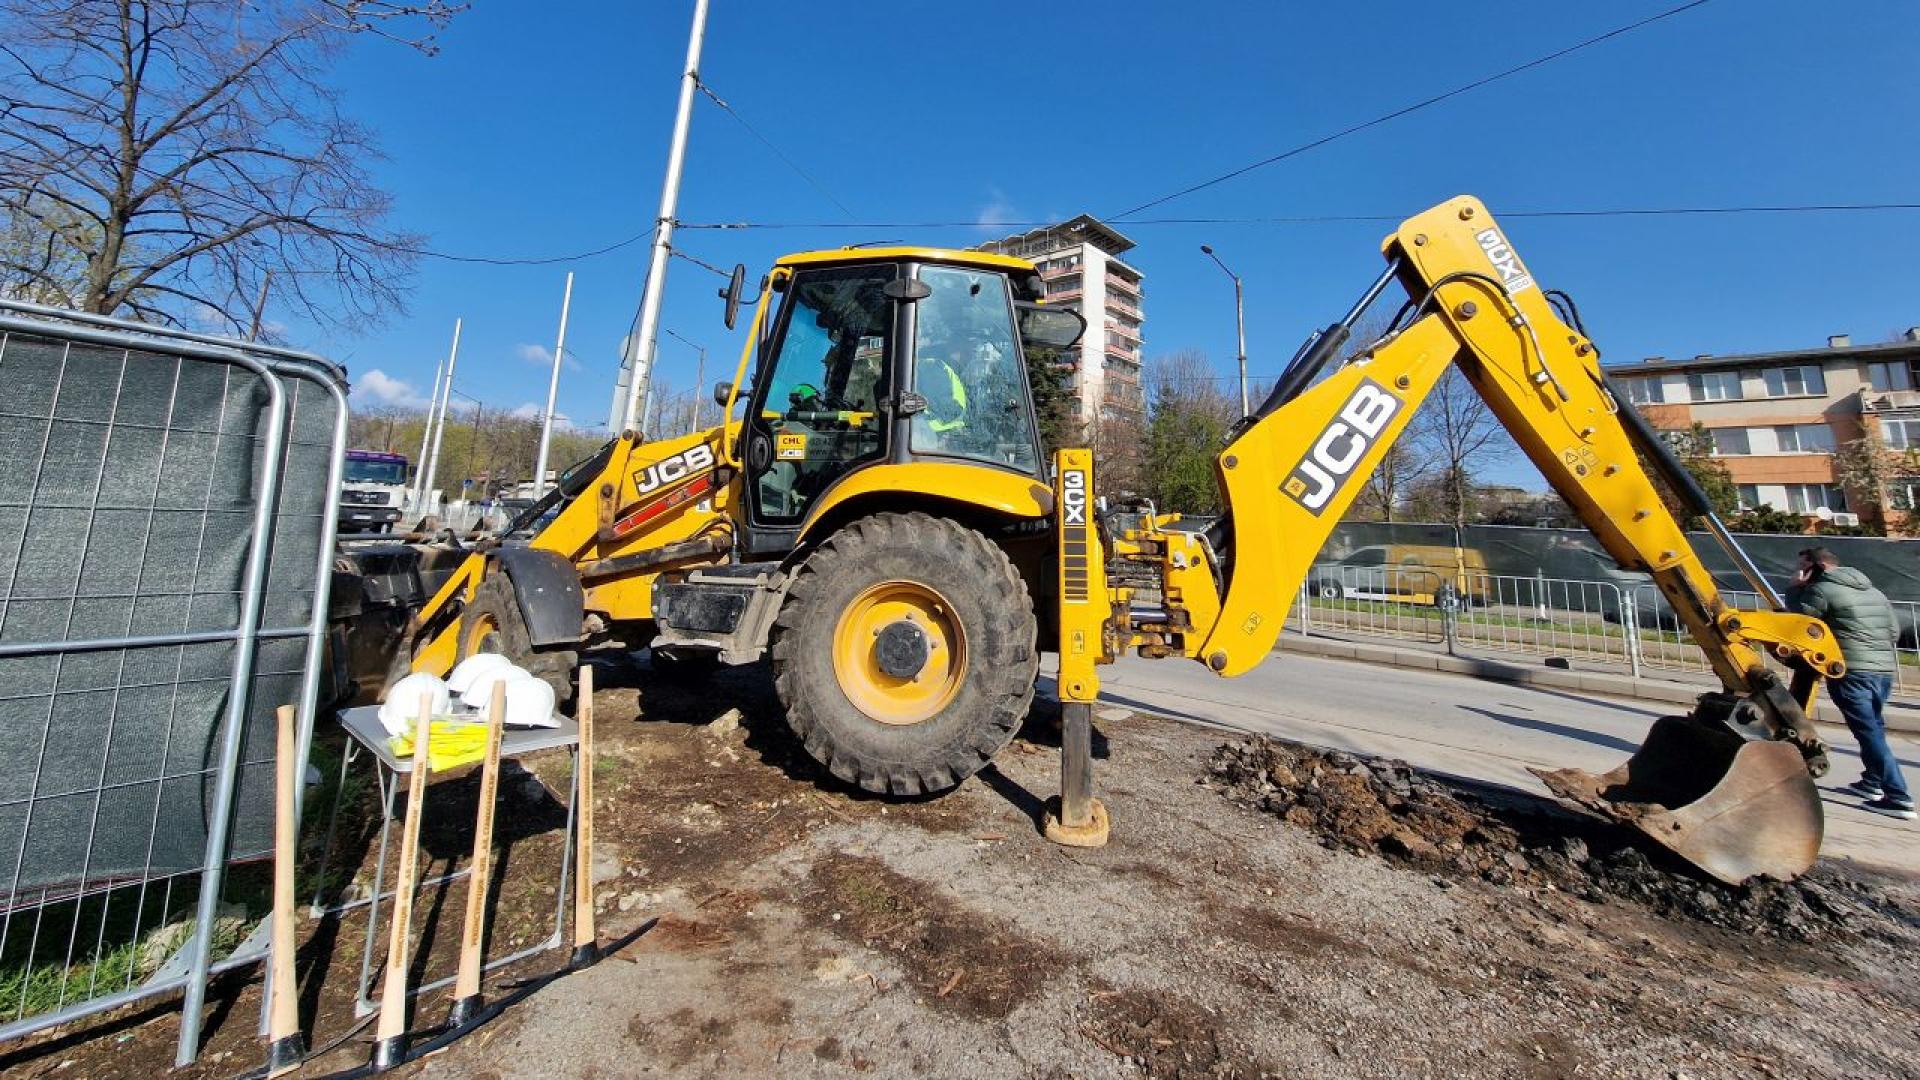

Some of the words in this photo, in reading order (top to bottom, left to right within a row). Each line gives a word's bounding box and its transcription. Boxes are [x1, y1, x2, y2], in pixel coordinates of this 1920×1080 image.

[1477, 229, 1523, 281] 3CX
[638, 444, 714, 493] JCB
[1300, 384, 1398, 508] JCB
[1064, 470, 1085, 523] 3CX
